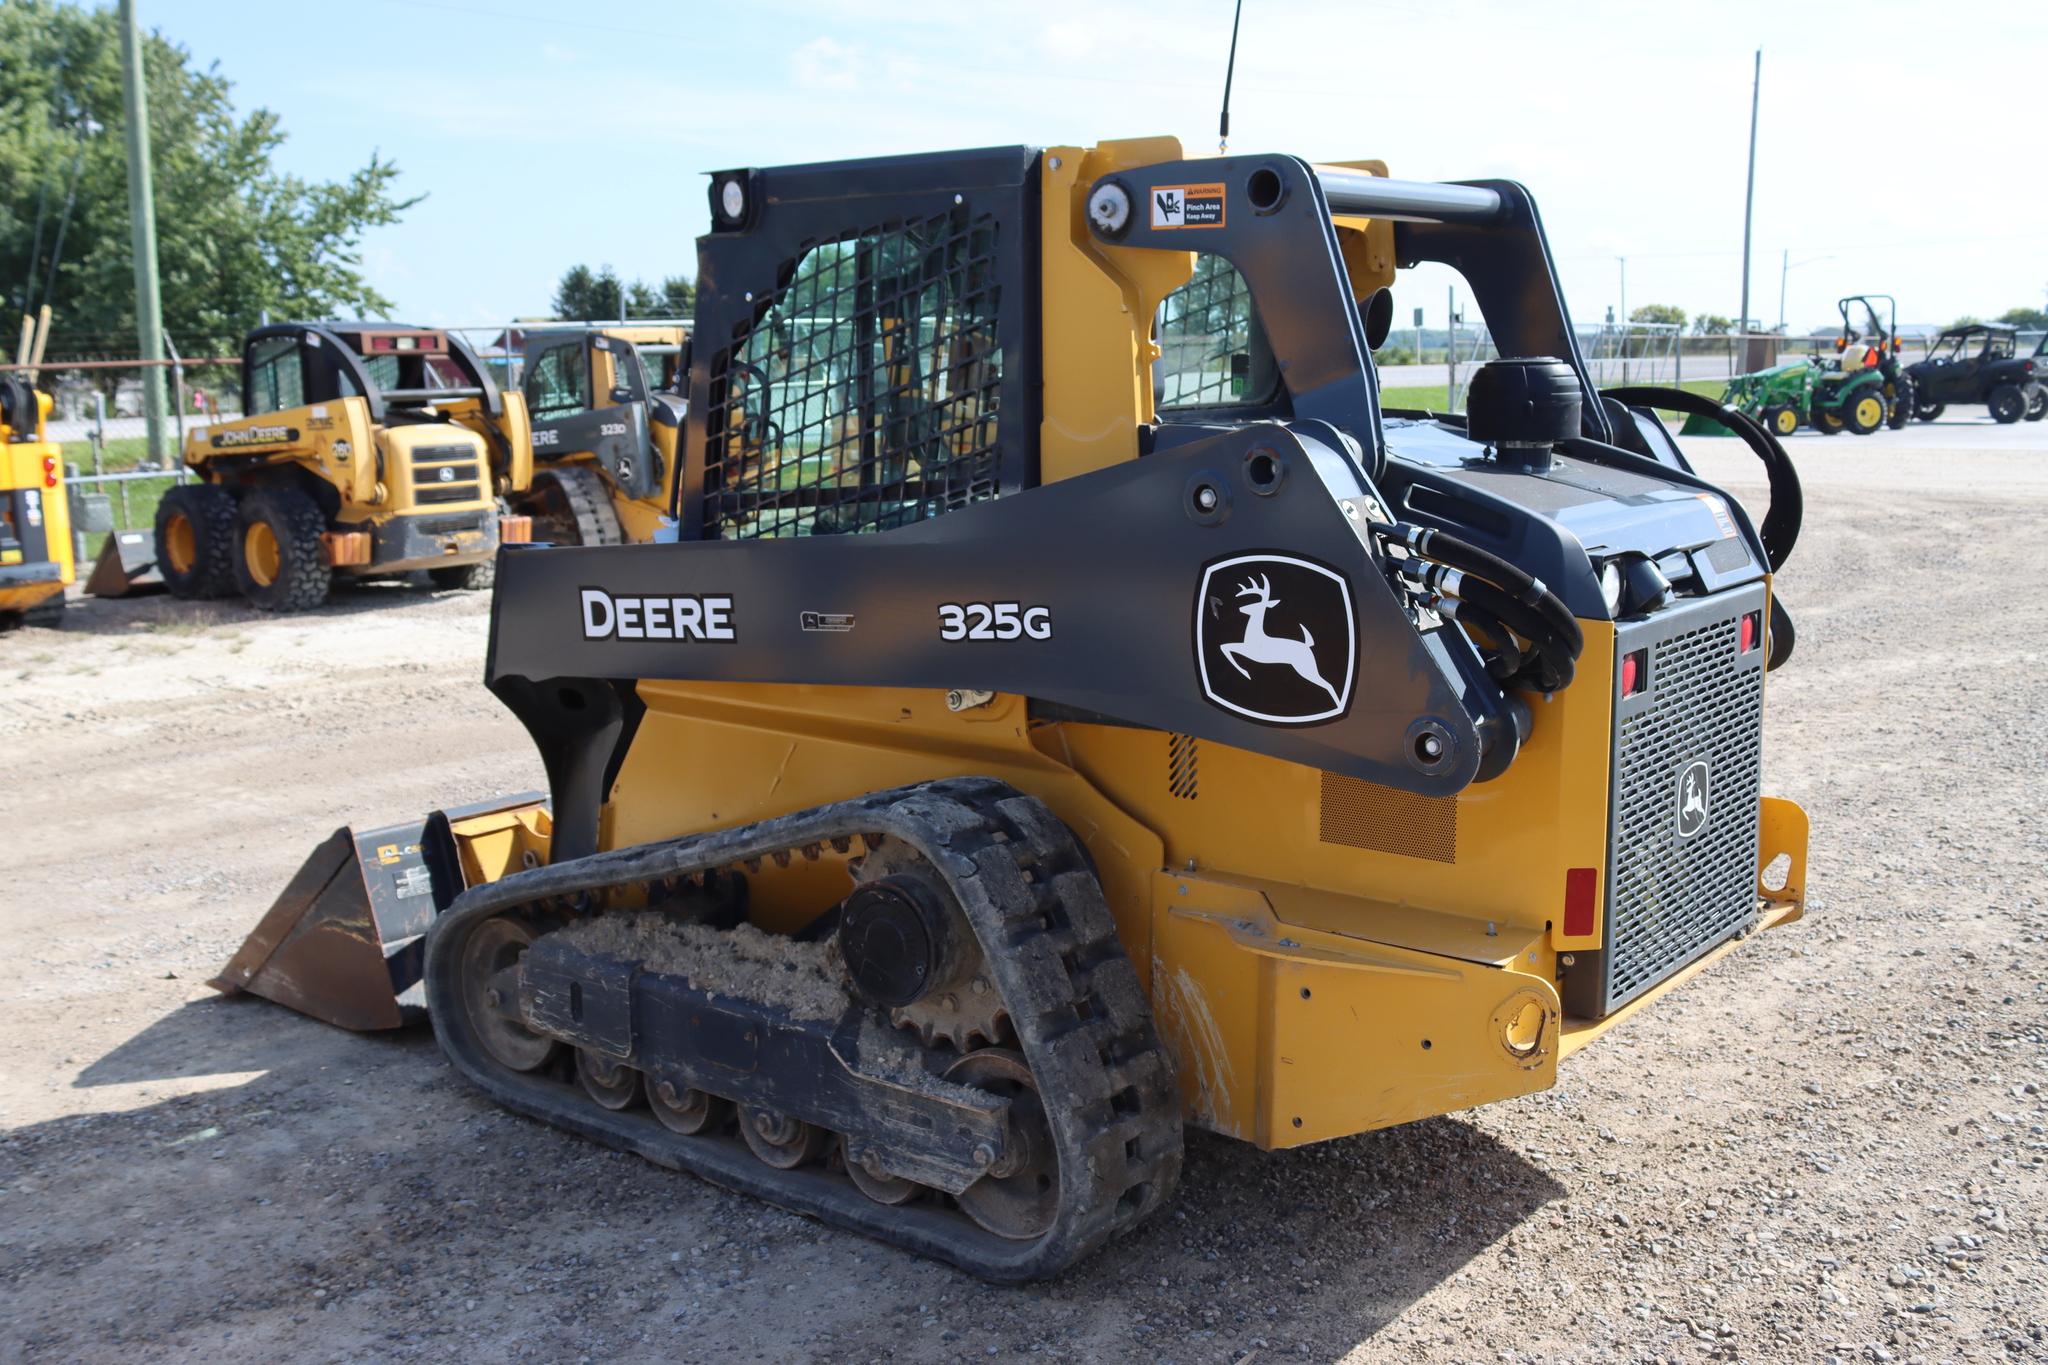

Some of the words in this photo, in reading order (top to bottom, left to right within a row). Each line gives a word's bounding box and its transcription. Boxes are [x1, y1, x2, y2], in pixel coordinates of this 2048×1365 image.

[221, 428, 250, 446] JOHN
[250, 425, 288, 442] DEERE
[531, 430, 560, 447] ERE
[600, 423, 627, 436] 323D
[331, 442, 352, 457] 260
[581, 589, 735, 640] DEERE
[938, 602, 1051, 641] 325G
